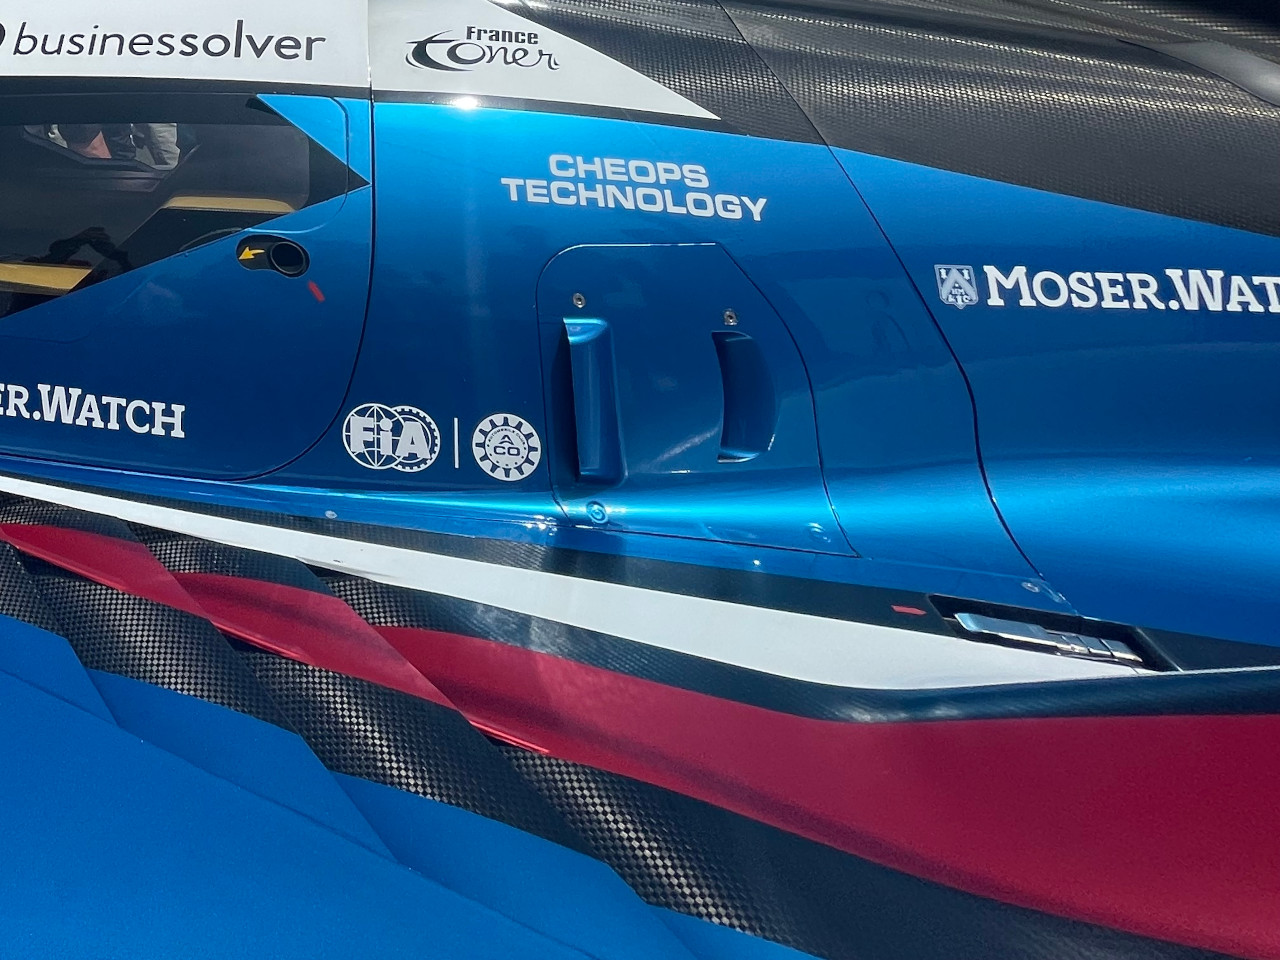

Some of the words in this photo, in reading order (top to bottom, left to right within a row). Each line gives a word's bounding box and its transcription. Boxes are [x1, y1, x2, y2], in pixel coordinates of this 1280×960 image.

[12, 19, 327, 61] businessolver
[466, 26, 539, 45] France
[548, 154, 710, 188] CHEOPS
[500, 177, 768, 222] TECHNOLOGY
